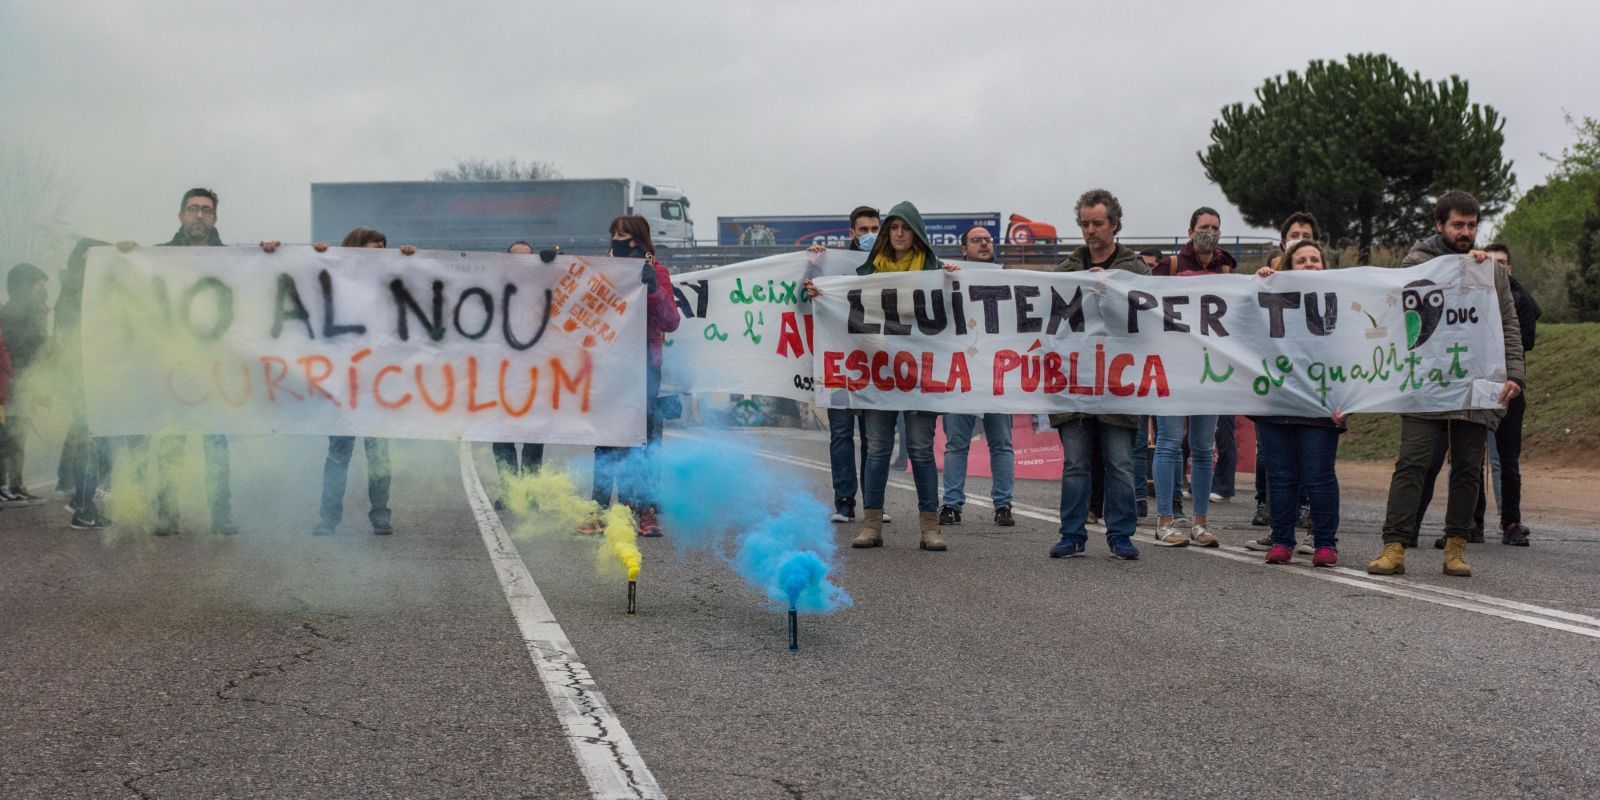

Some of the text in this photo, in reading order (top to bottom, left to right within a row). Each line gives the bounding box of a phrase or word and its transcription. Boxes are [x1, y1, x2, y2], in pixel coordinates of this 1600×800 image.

[104, 268, 553, 351] NO AL NOU
[703, 322, 729, 342] a
[1127, 289, 1230, 338] PER
[1257, 291, 1338, 338] TU
[1445, 306, 1479, 326] DUC
[166, 346, 593, 418] CURRÍCULUM
[823, 349, 972, 394] ESCOLA
[1200, 346, 1235, 384] i
[1252, 354, 1294, 397] de
[1306, 342, 1469, 407] qualitat
